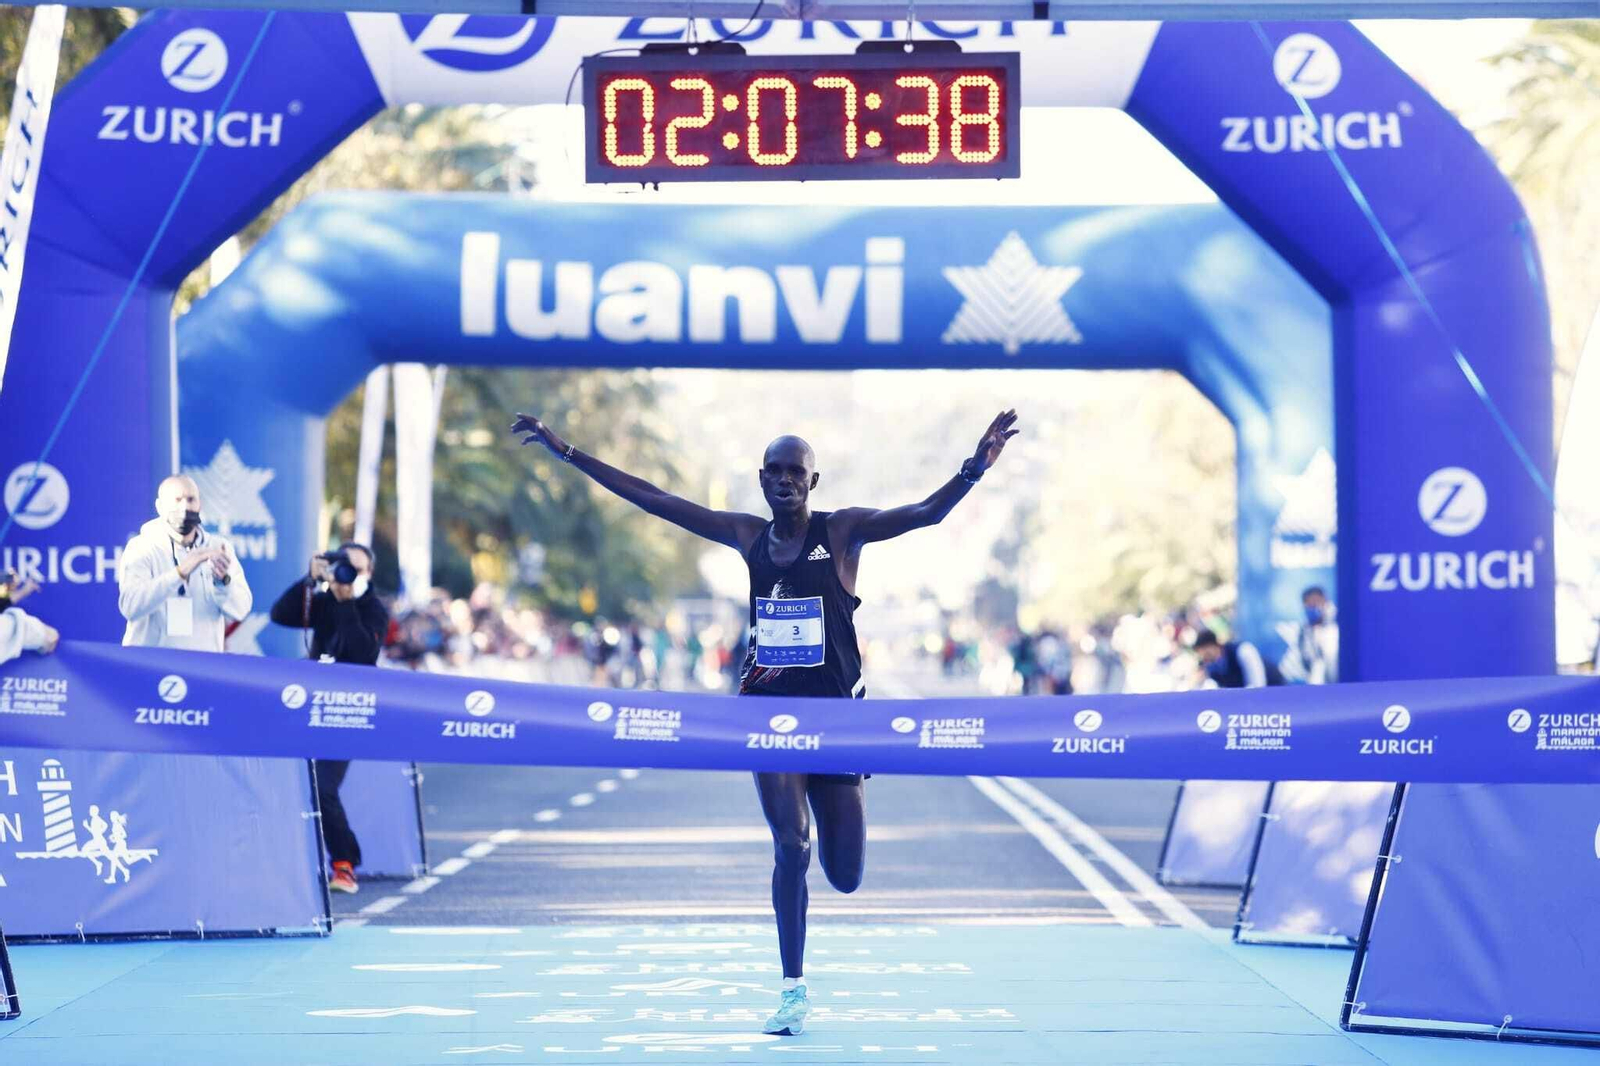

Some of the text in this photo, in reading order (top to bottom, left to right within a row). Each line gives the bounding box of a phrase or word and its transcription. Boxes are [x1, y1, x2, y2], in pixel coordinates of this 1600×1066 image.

[98, 105, 284, 148] ZURICH
[604, 75, 1000, 166] 02:07:38
[1220, 111, 1403, 153] ZURICH
[459, 231, 904, 343] luanvi
[1370, 550, 1535, 592] ZURICH
[776, 604, 807, 613] ZURICH
[792, 625, 800, 636] 3
[3, 677, 67, 693] ZURICH
[312, 690, 376, 707] ZURICH
[134, 707, 209, 727] ZURICH
[618, 706, 681, 722] ZURICH
[1227, 714, 1292, 729] ZURICH
[1538, 713, 1600, 728] ZURICH
[441, 720, 516, 740] ZURICH
[921, 718, 984, 730] ZURICH
[746, 732, 820, 750] ZURICH
[1051, 737, 1125, 754] ZURICH
[1359, 739, 1434, 755] ZURICH
